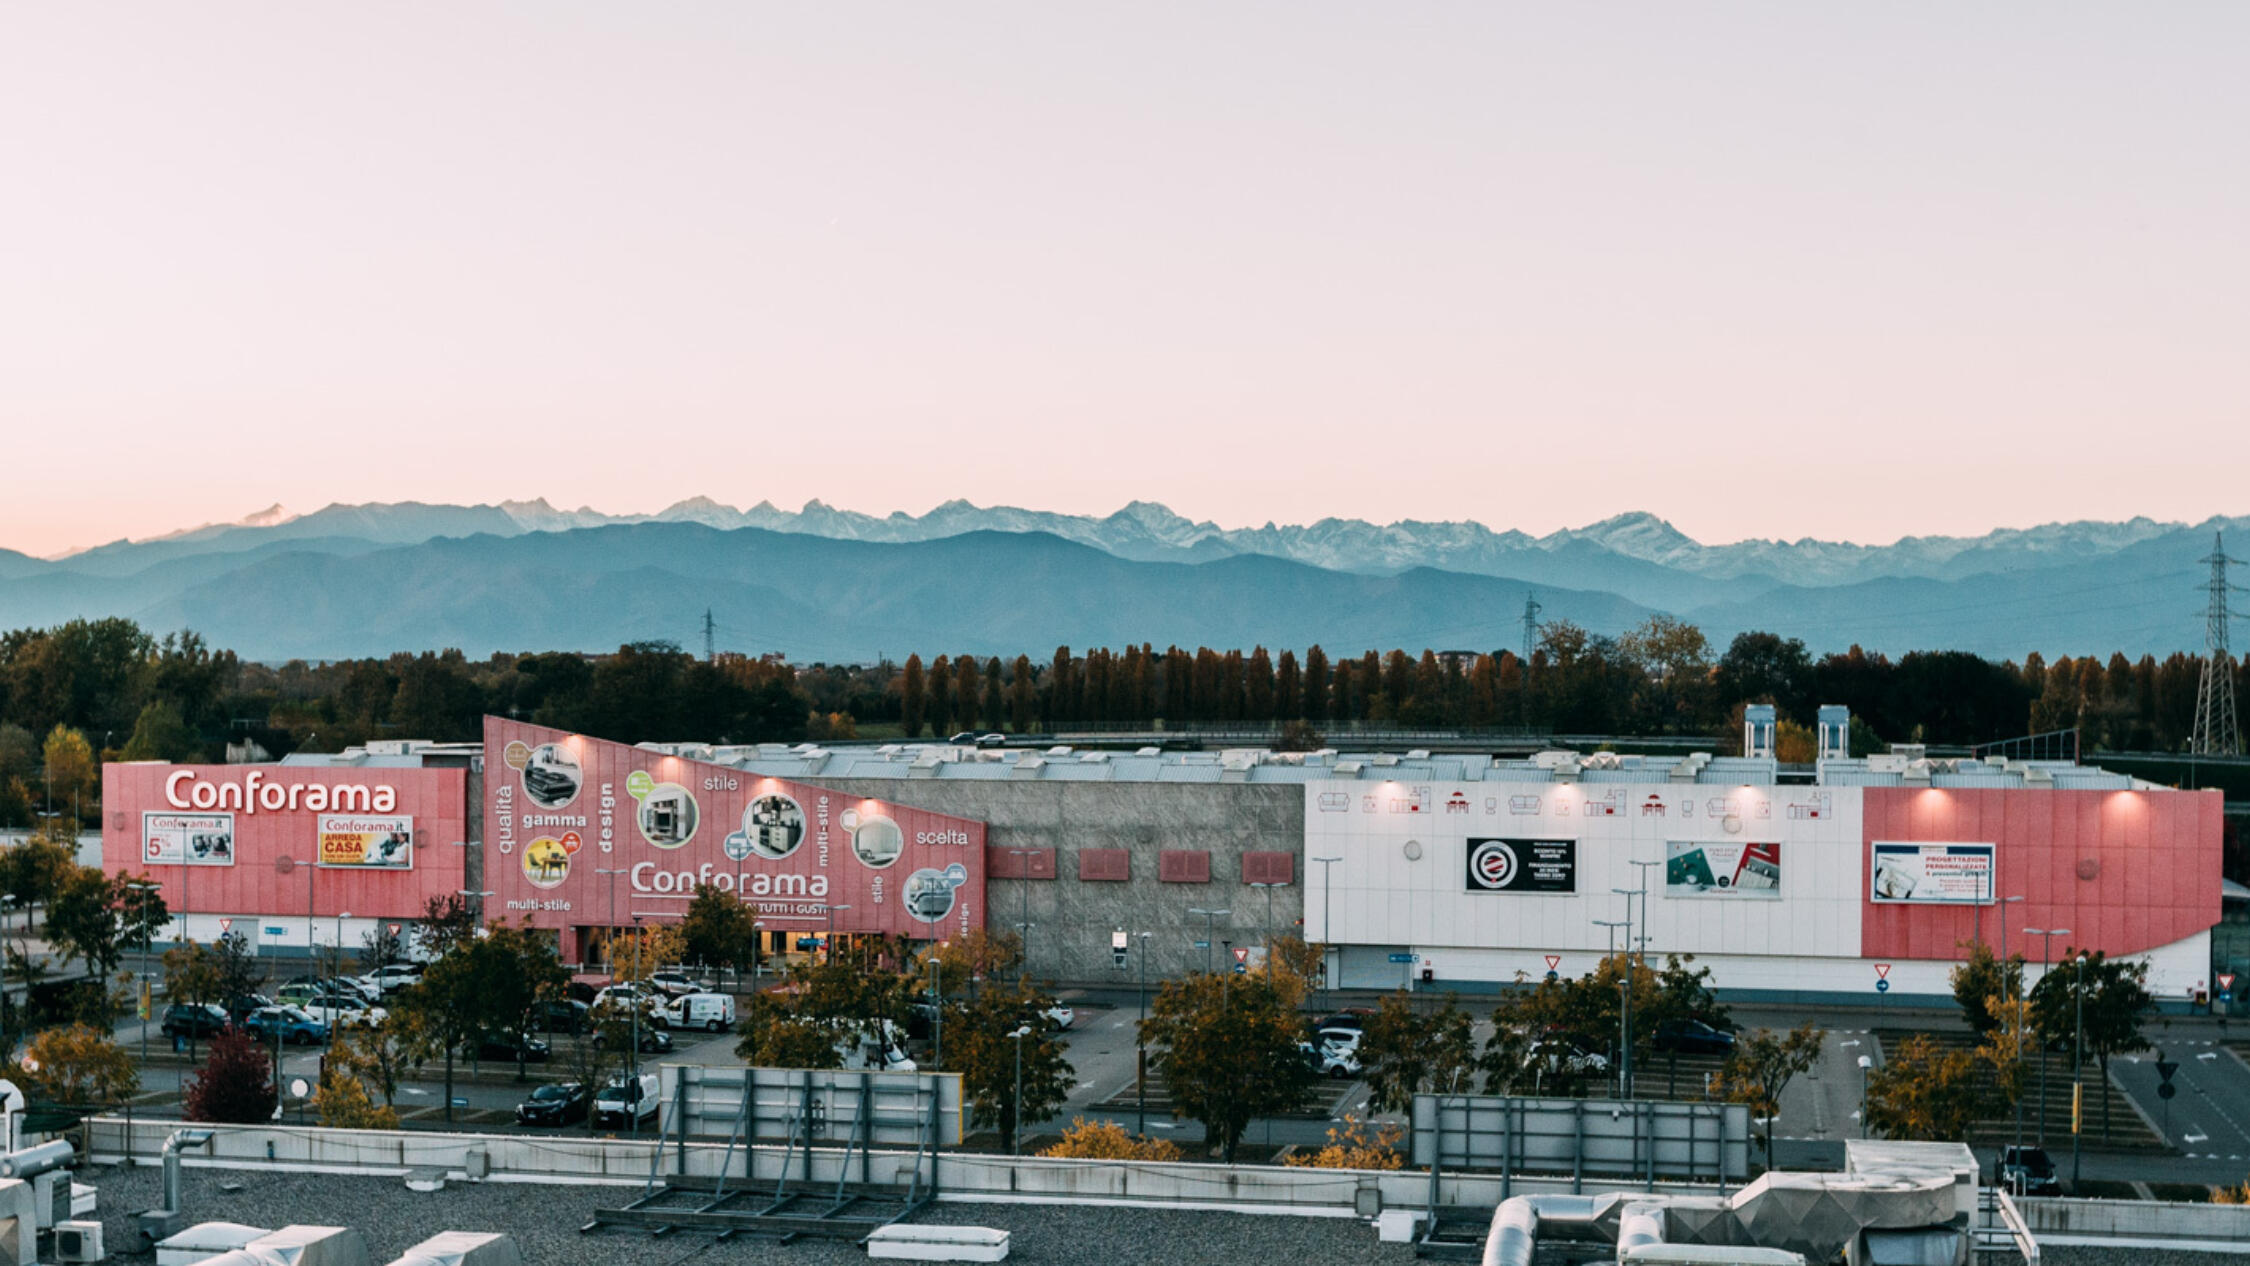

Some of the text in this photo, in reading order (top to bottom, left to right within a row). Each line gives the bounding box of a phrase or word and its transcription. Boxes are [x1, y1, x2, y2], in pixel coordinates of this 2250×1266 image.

[704, 775, 739, 791] stile
[165, 769, 397, 814] Conforama
[495, 784, 516, 854] qualità
[523, 814, 587, 829] gamma
[599, 783, 616, 853] design
[325, 833, 362, 841] ARREDA
[817, 796, 829, 867] multi-stile
[916, 829, 968, 845] scelta
[325, 842, 363, 853] CASA
[631, 861, 829, 896] Conforama
[872, 876, 884, 904] stile
[507, 898, 572, 912] multi-stile
[759, 903, 788, 913] TUTTI
[796, 904, 827, 915] GUSTI
